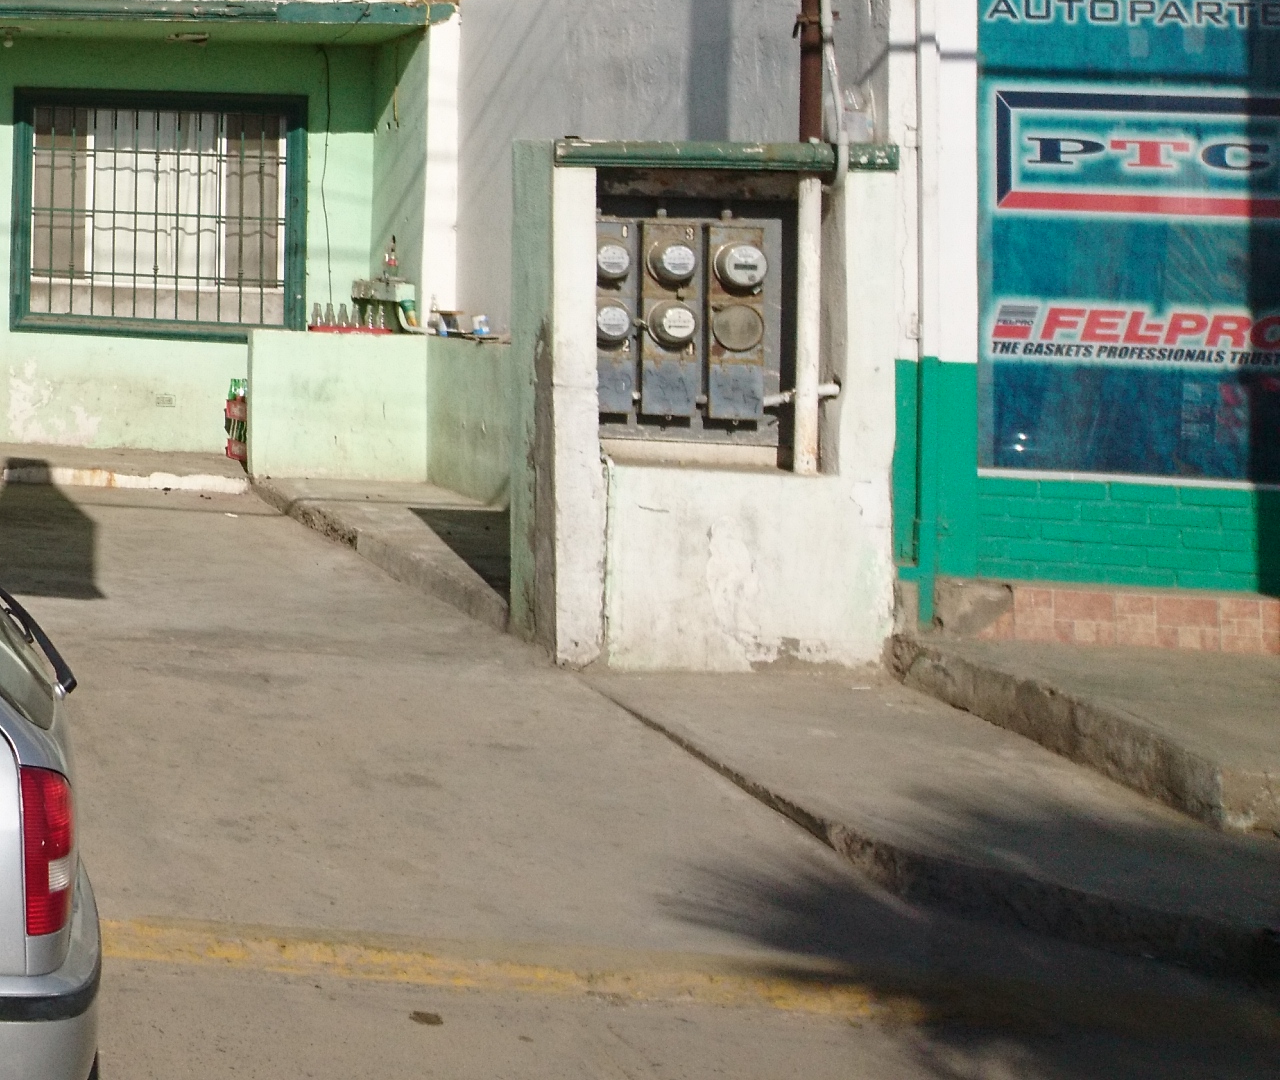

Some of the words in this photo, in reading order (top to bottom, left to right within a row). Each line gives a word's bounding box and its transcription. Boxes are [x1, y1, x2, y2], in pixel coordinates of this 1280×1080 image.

[1027, 137, 1270, 170] PTC
[992, 340, 1019, 355] THE
[1023, 341, 1092, 358] GASKETS
[1096, 346, 1225, 363] PROFESSIONALS
